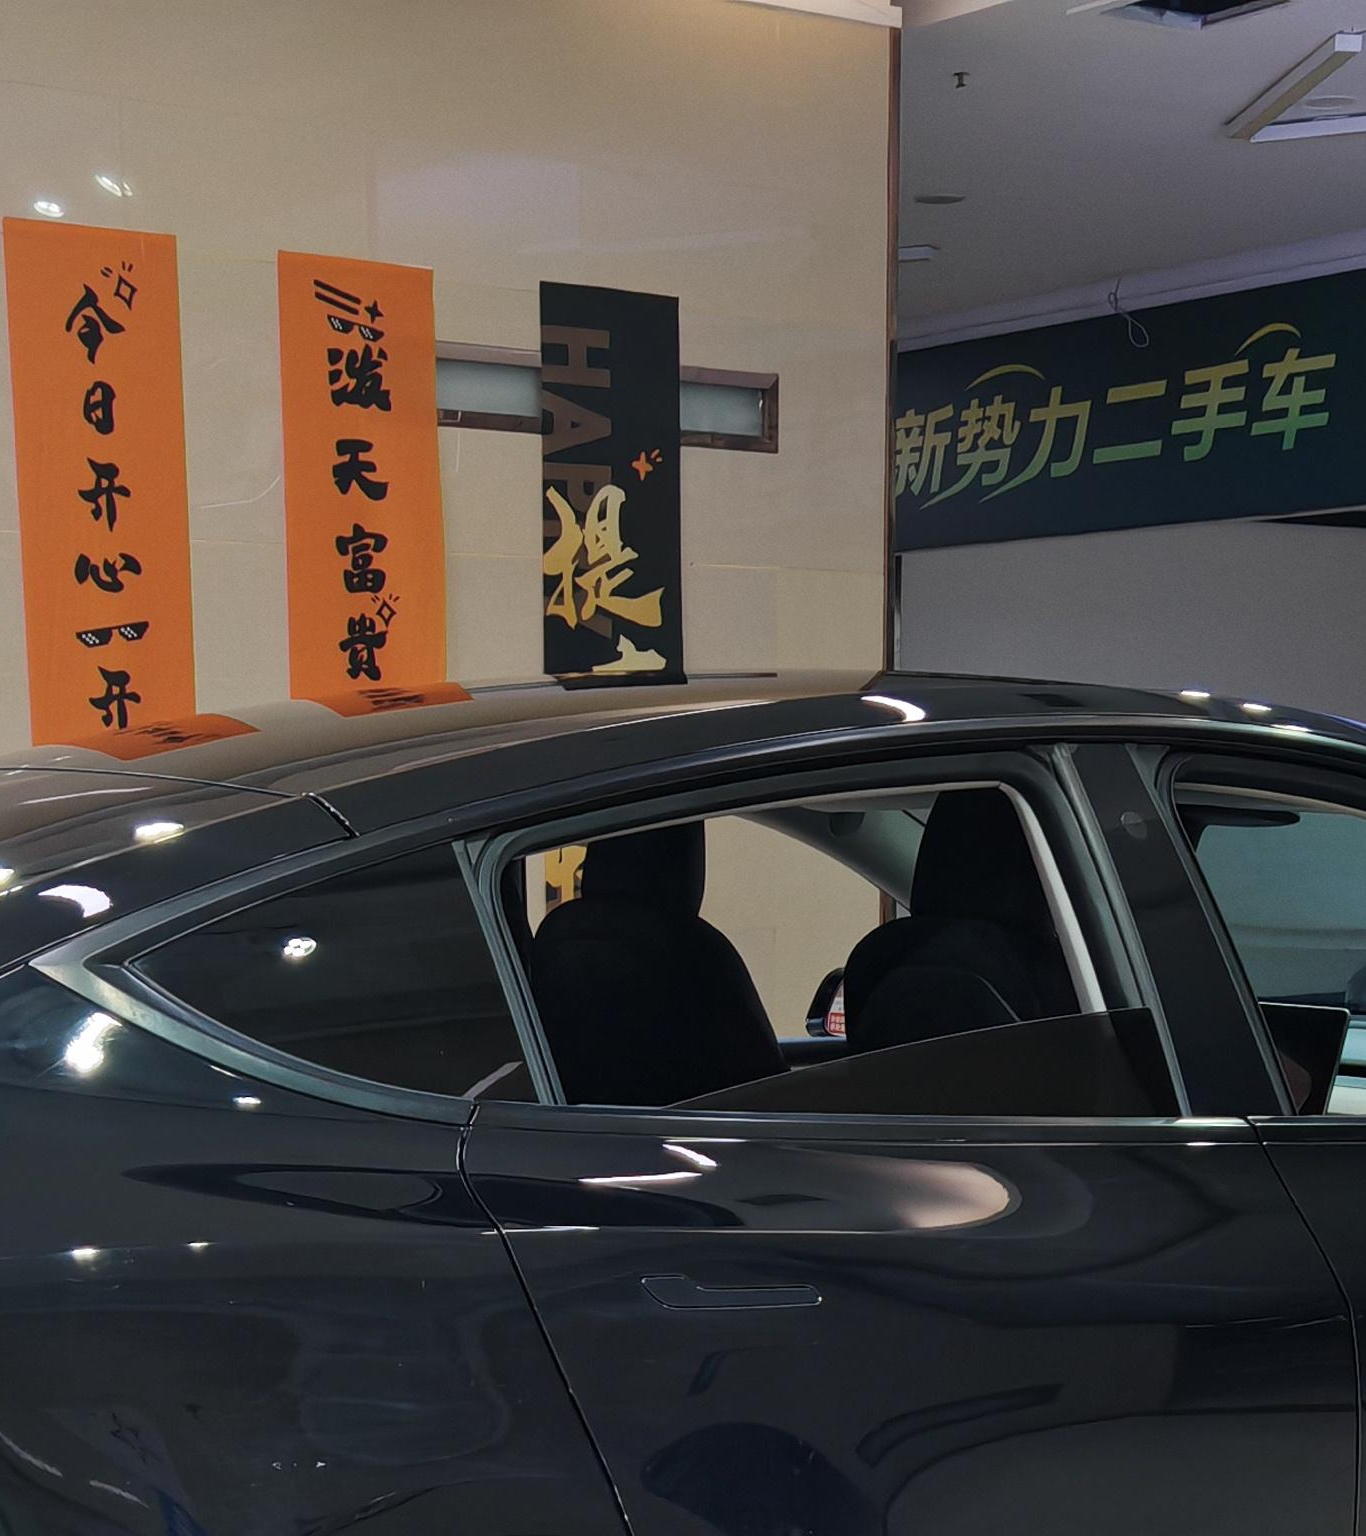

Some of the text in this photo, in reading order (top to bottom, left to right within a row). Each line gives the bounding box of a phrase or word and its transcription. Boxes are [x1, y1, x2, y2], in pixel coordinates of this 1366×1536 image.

[894, 346, 1336, 511] 新势力二手车
